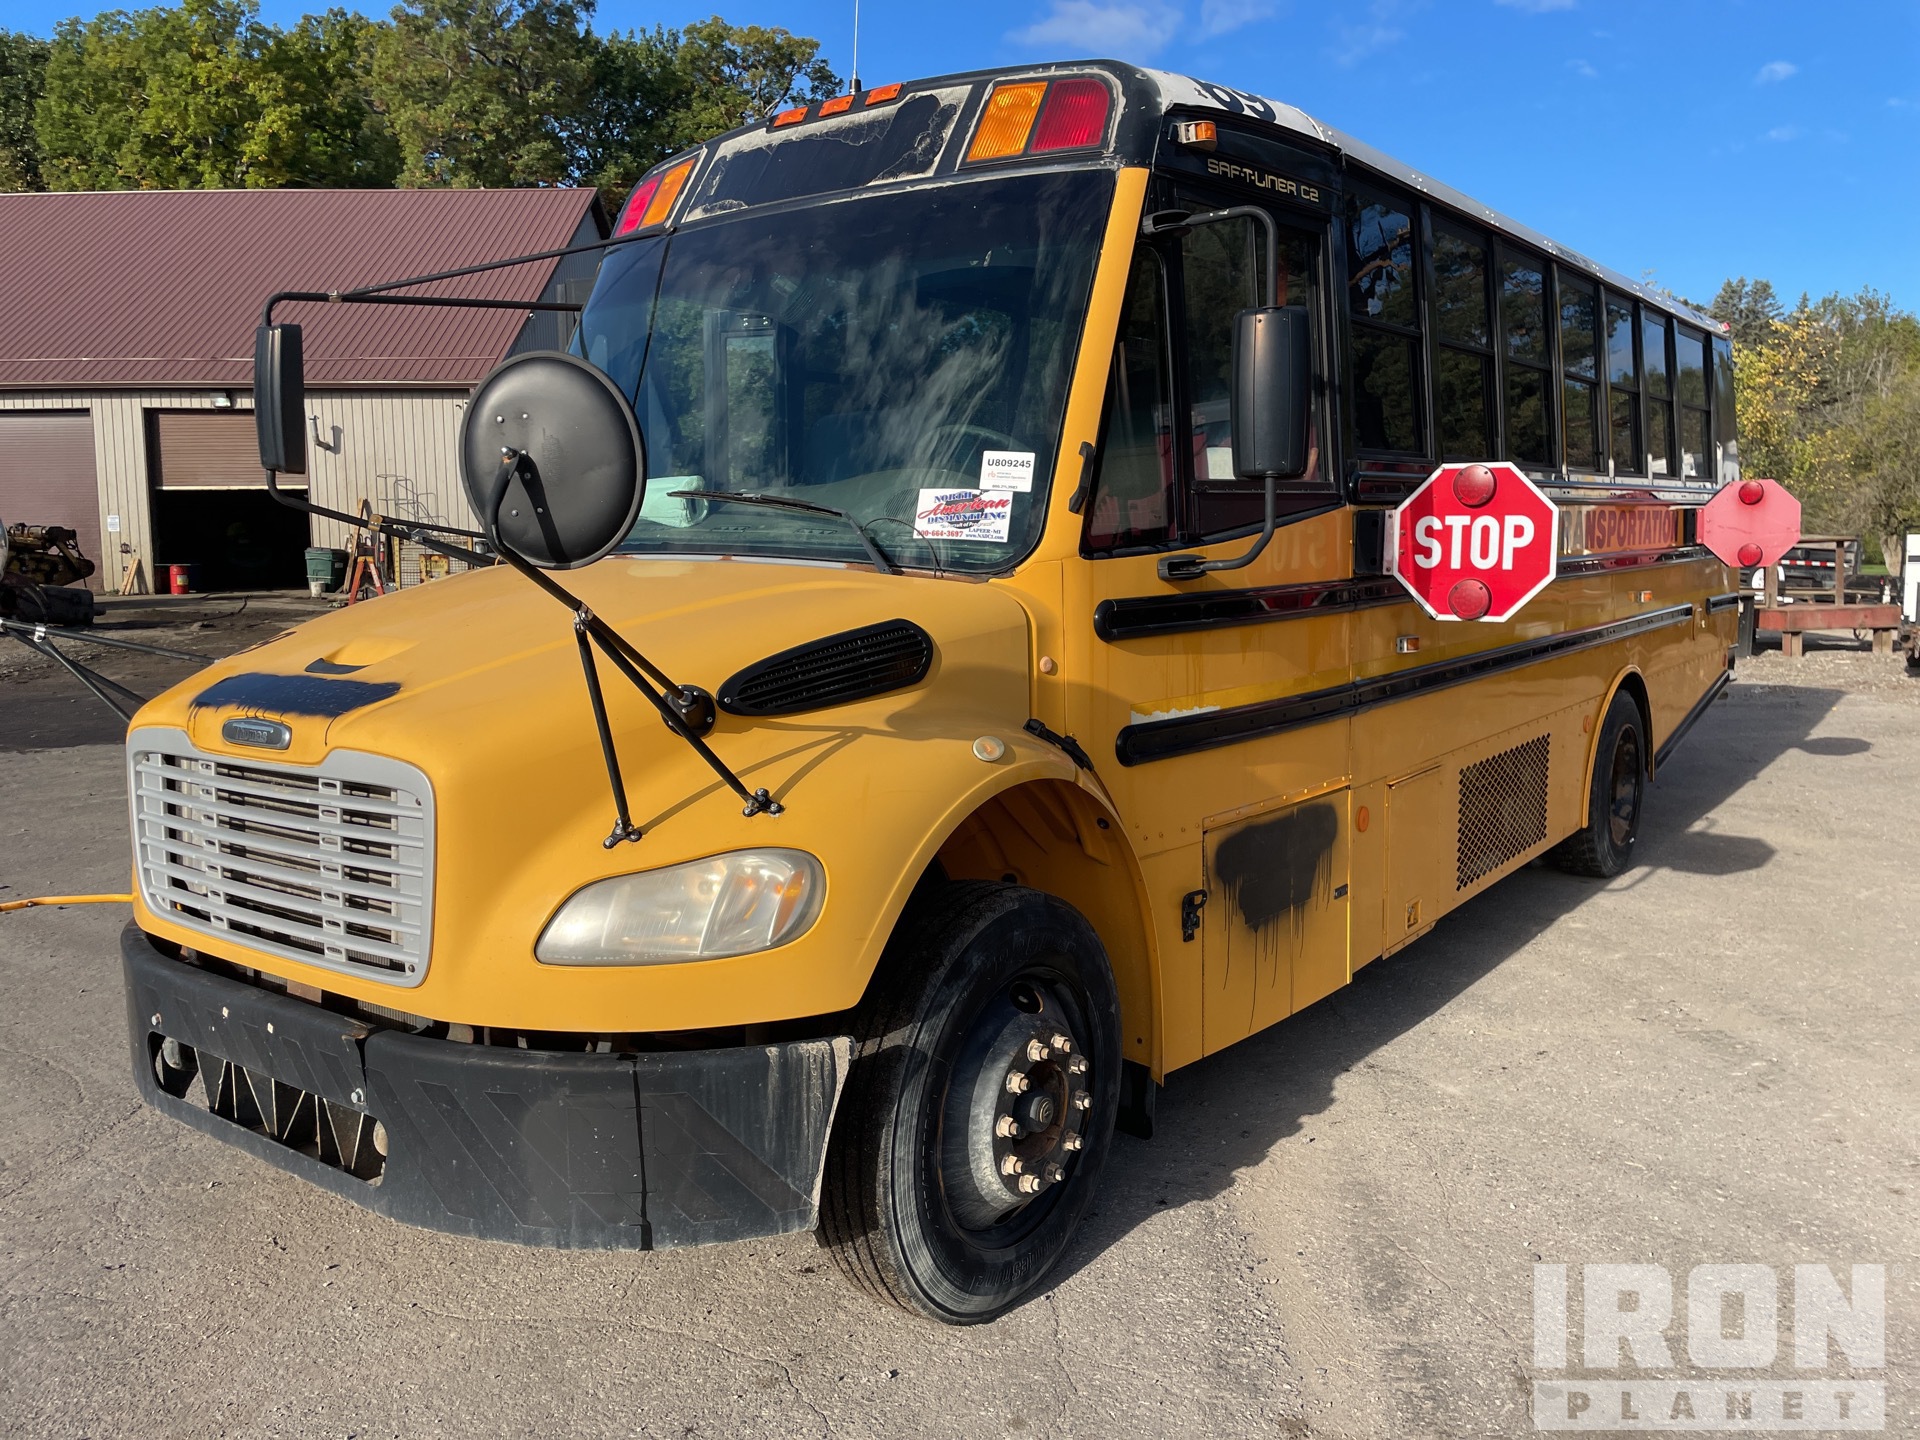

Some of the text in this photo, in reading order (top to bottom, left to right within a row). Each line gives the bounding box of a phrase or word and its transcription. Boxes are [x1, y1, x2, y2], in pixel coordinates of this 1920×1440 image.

[1300, 184, 1319, 203] C2
[987, 458, 1032, 468] U809245
[933, 490, 973, 503] NORTH
[917, 497, 1011, 519] American
[926, 511, 1008, 524] DISMANTLING
[1561, 509, 1679, 553] RANSPORTATION
[1414, 514, 1535, 571] STOP
